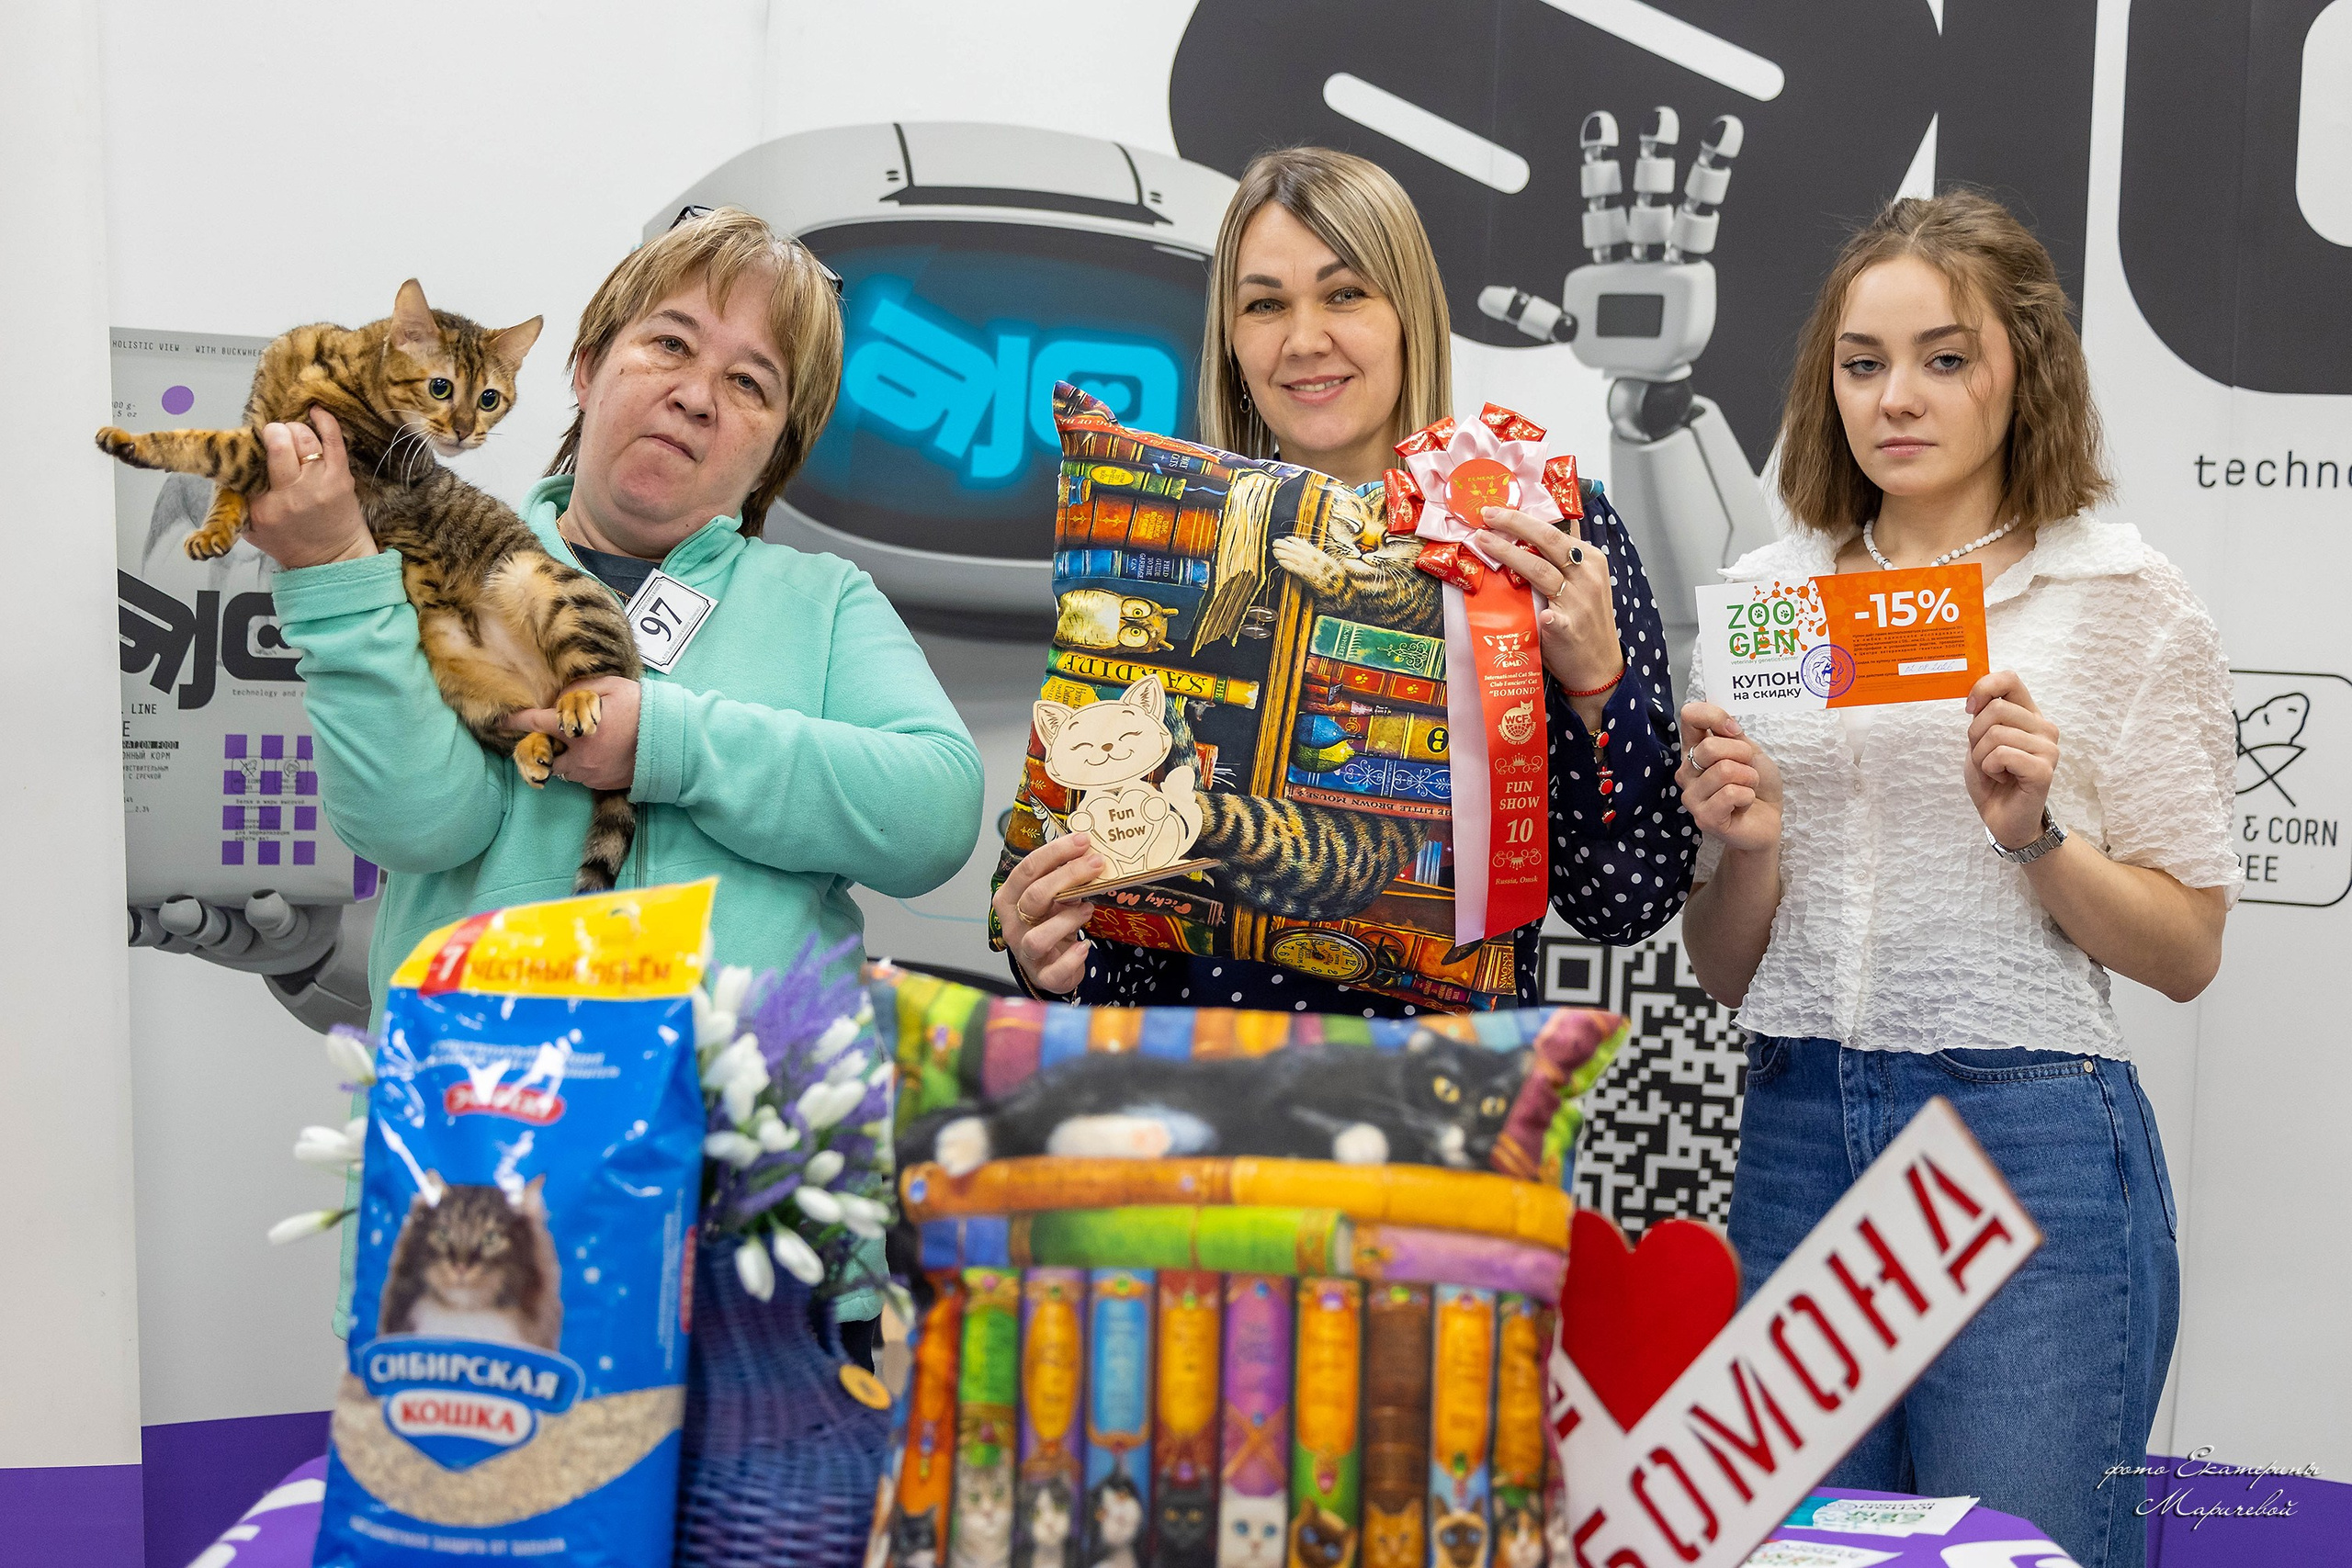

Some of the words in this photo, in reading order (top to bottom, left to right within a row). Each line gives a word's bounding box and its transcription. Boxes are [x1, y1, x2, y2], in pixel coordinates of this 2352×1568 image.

[112, 340, 153, 350] HOLISTIC
[159, 343, 180, 352] VIEW
[195, 345, 216, 355] WITH
[2194, 450, 2352, 489] techn
[1137, 552, 1147, 580] GARBAGE
[1147, 557, 1154, 565] TO
[1154, 558, 1162, 577] GUIDE
[1162, 559, 1170, 578] FIELD
[1726, 600, 1795, 630] ZOO
[1854, 587, 1960, 628] -15%
[639, 596, 683, 642] 97
[1728, 628, 1796, 658] GEN
[1484, 672, 1519, 681] International
[1732, 671, 1801, 690] КУПОН
[232, 688, 277, 698] technology
[1216, 679, 1227, 699] THE
[1733, 691, 1749, 701] на
[1753, 687, 1802, 700] скидку
[131, 703, 157, 715] LINE
[151, 750, 171, 761] КОРМ
[1505, 780, 1533, 795] FUN
[1306, 792, 1347, 805] MOUSE
[1351, 798, 1395, 810] BROWN
[1499, 795, 1540, 811] SHOW
[1108, 808, 1135, 822] Fun
[1399, 805, 1434, 816] LITTLE
[1107, 825, 1146, 842] Show
[1505, 818, 1534, 844] 10
[2265, 816, 2337, 847] CORN
[1495, 876, 1519, 886] Russia,
[1519, 874, 1539, 885] Omsk
[1105, 889, 1141, 907] Mo
[1145, 892, 1193, 915] Picky
[1498, 952, 1509, 989] KNOWN
[369, 1352, 560, 1401] СИБИРСКАЯ
[401, 1400, 516, 1436] КОШКА
